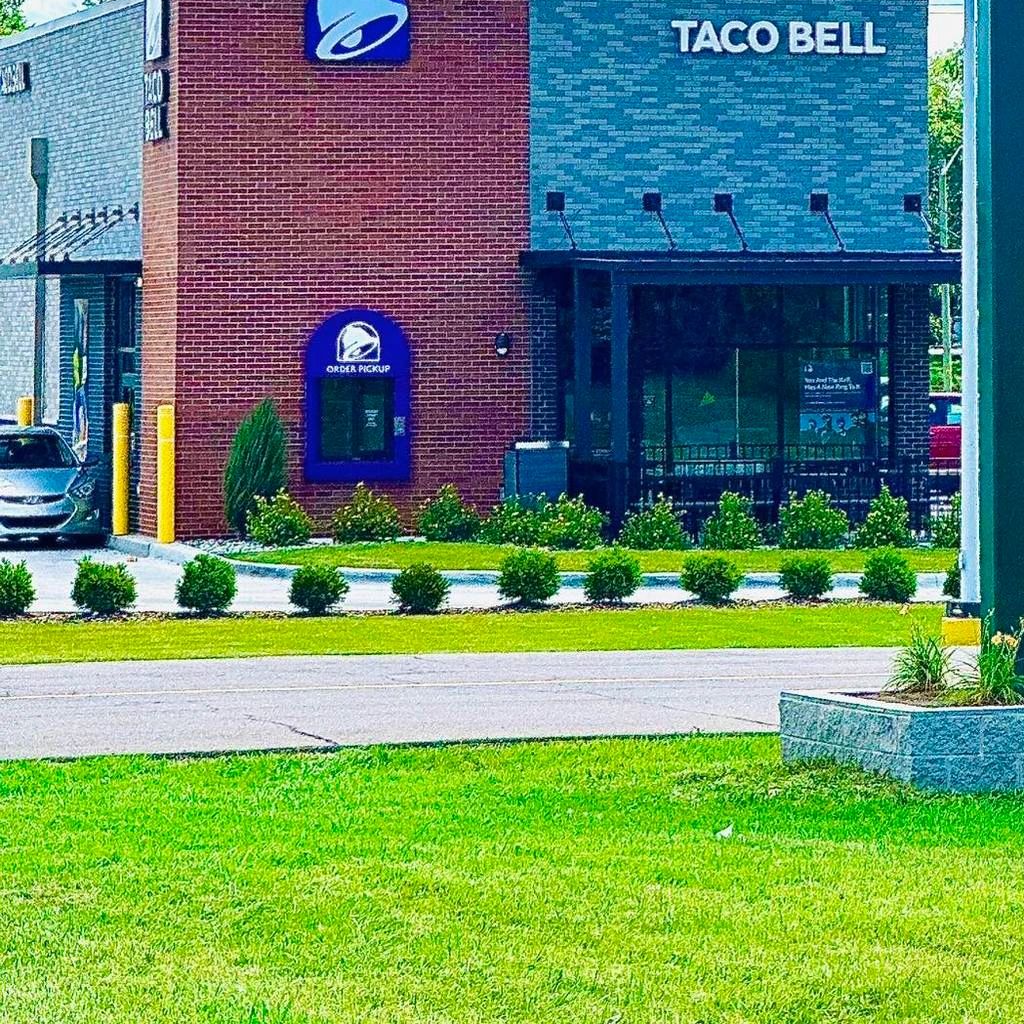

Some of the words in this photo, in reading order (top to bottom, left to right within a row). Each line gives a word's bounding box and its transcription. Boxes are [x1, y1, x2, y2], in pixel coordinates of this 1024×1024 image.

[671, 20, 779, 53] TACO
[789, 21, 886, 54] BELL
[326, 365, 357, 374] ORDER
[358, 365, 391, 374] PICKUP
